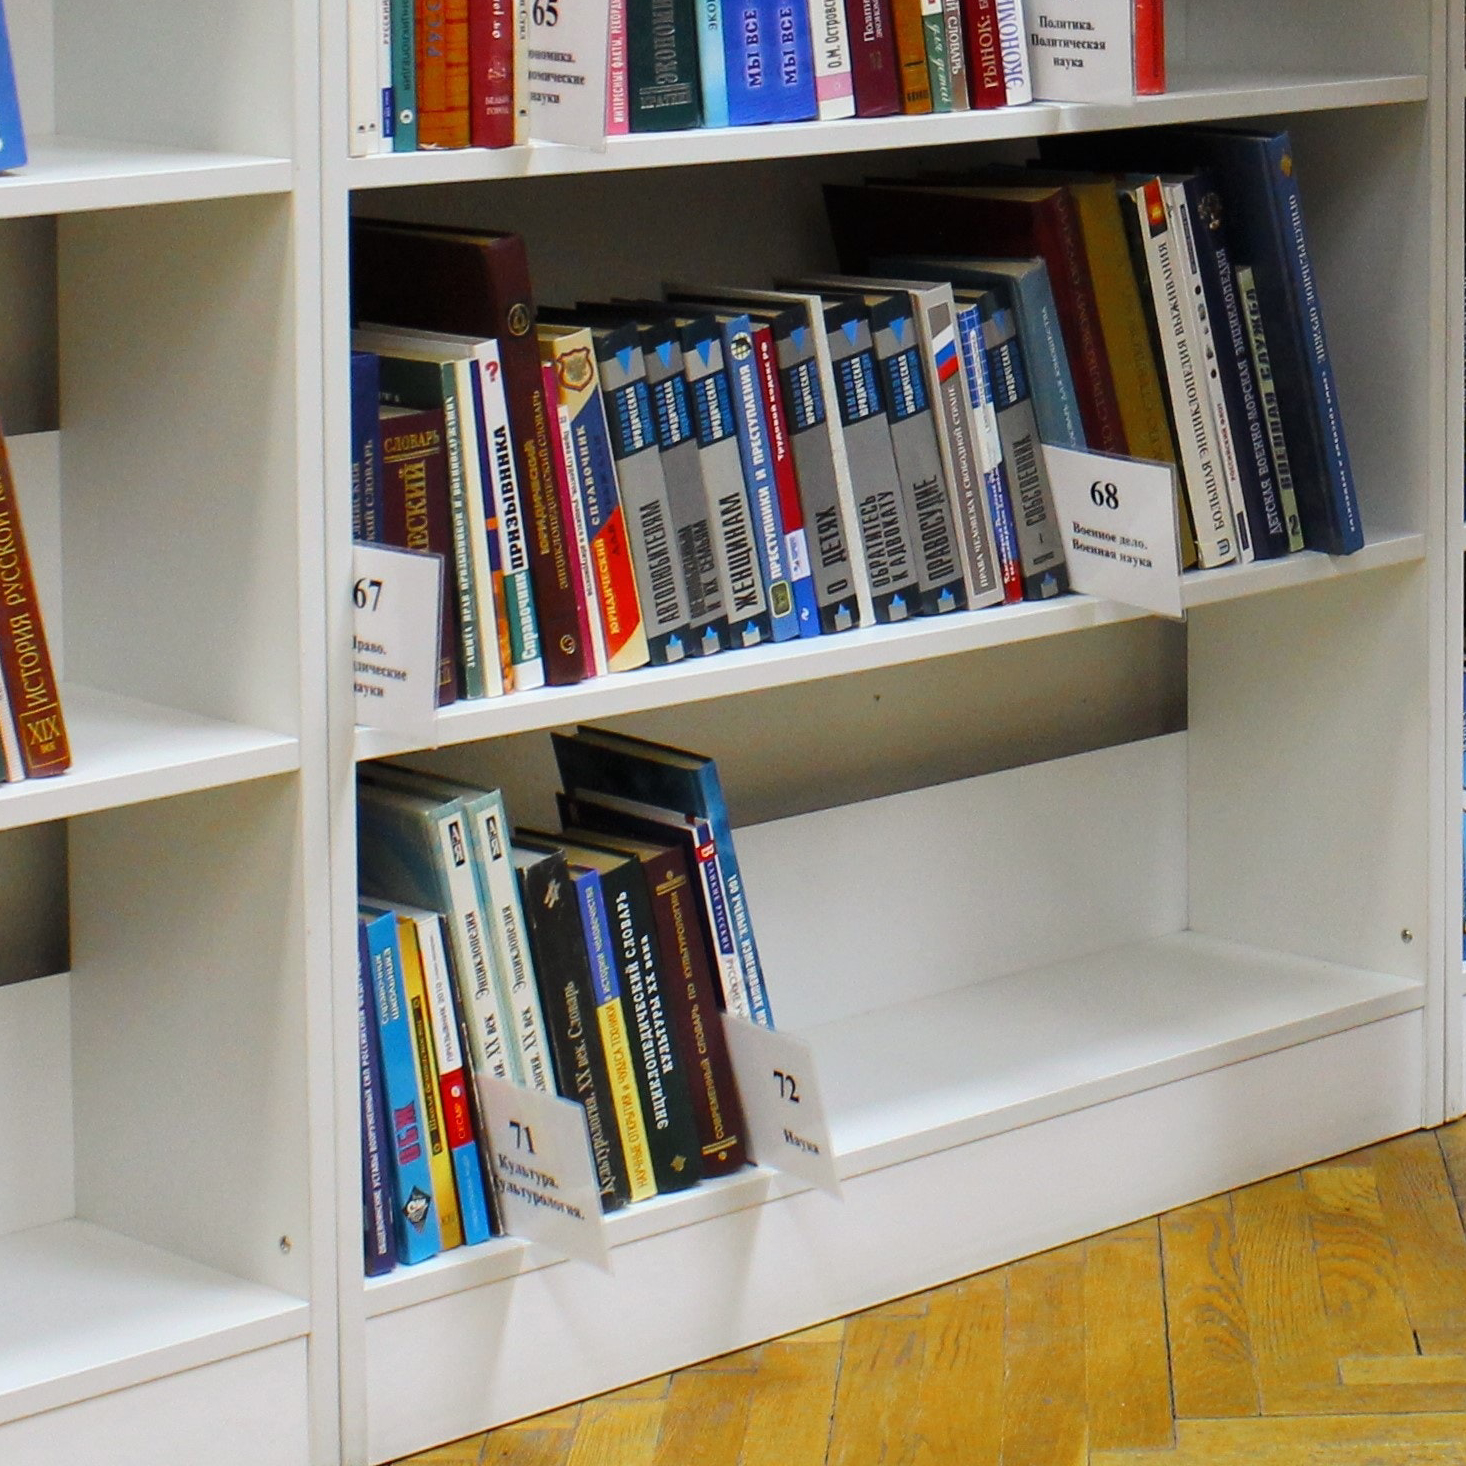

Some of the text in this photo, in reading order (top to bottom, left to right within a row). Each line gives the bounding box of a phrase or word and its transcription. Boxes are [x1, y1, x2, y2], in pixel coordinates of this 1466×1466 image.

[744, 9, 759, 46] ВСЕ
[780, 7, 795, 43] ВСЕ
[1039, 14, 1096, 32] Политика.
[946, 15, 962, 76] СЛОВАРЬ
[1031, 34, 1106, 52] Политическая
[747, 51, 763, 88] МЫ
[782, 49, 798, 85] МЫ
[1052, 56, 1085, 70] наука
[1288, 194, 1327, 364] ОГНЕСТРЕЛЬНОЕ ОРУЖИЕ
[1157, 242, 1225, 531] БОЛЬШАЯ ЭНЦИКЛОПЕДИЯ ВЫЖИВАНИЯ
[576, 425, 600, 526] СПРАВОЧНИК
[1090, 481, 1120, 511] 68
[493, 425, 538, 659] Справочник ПРИЗЫВНИКА
[859, 494, 891, 588] ОБРАТИТЕСЬ
[913, 475, 955, 581] ПРАВОСУДИЕ
[1072, 520, 1149, 552] Военное дело.
[640, 499, 681, 625] АВТОЛЮБИТЕЛЯМ
[718, 492, 758, 612] ЖЕНЩИНАМ
[1072, 537, 1153, 570] Военная наука
[353, 578, 384, 612] 67
[592, 537, 620, 634] ЮРИДИЧЕСКИЙ
[615, 890, 670, 1131] ЭНЦИКЛОПЕДИЧЕСКИЙ СЛОВАРЬ
[639, 934, 674, 1076] КУЛЬТУРЫ XX века
[772, 1070, 801, 1104] 72
[393, 1100, 422, 1167] ОБЖ
[509, 1120, 536, 1155] 71
[784, 1127, 822, 1157] Наука
[499, 1152, 560, 1191] Культура.
